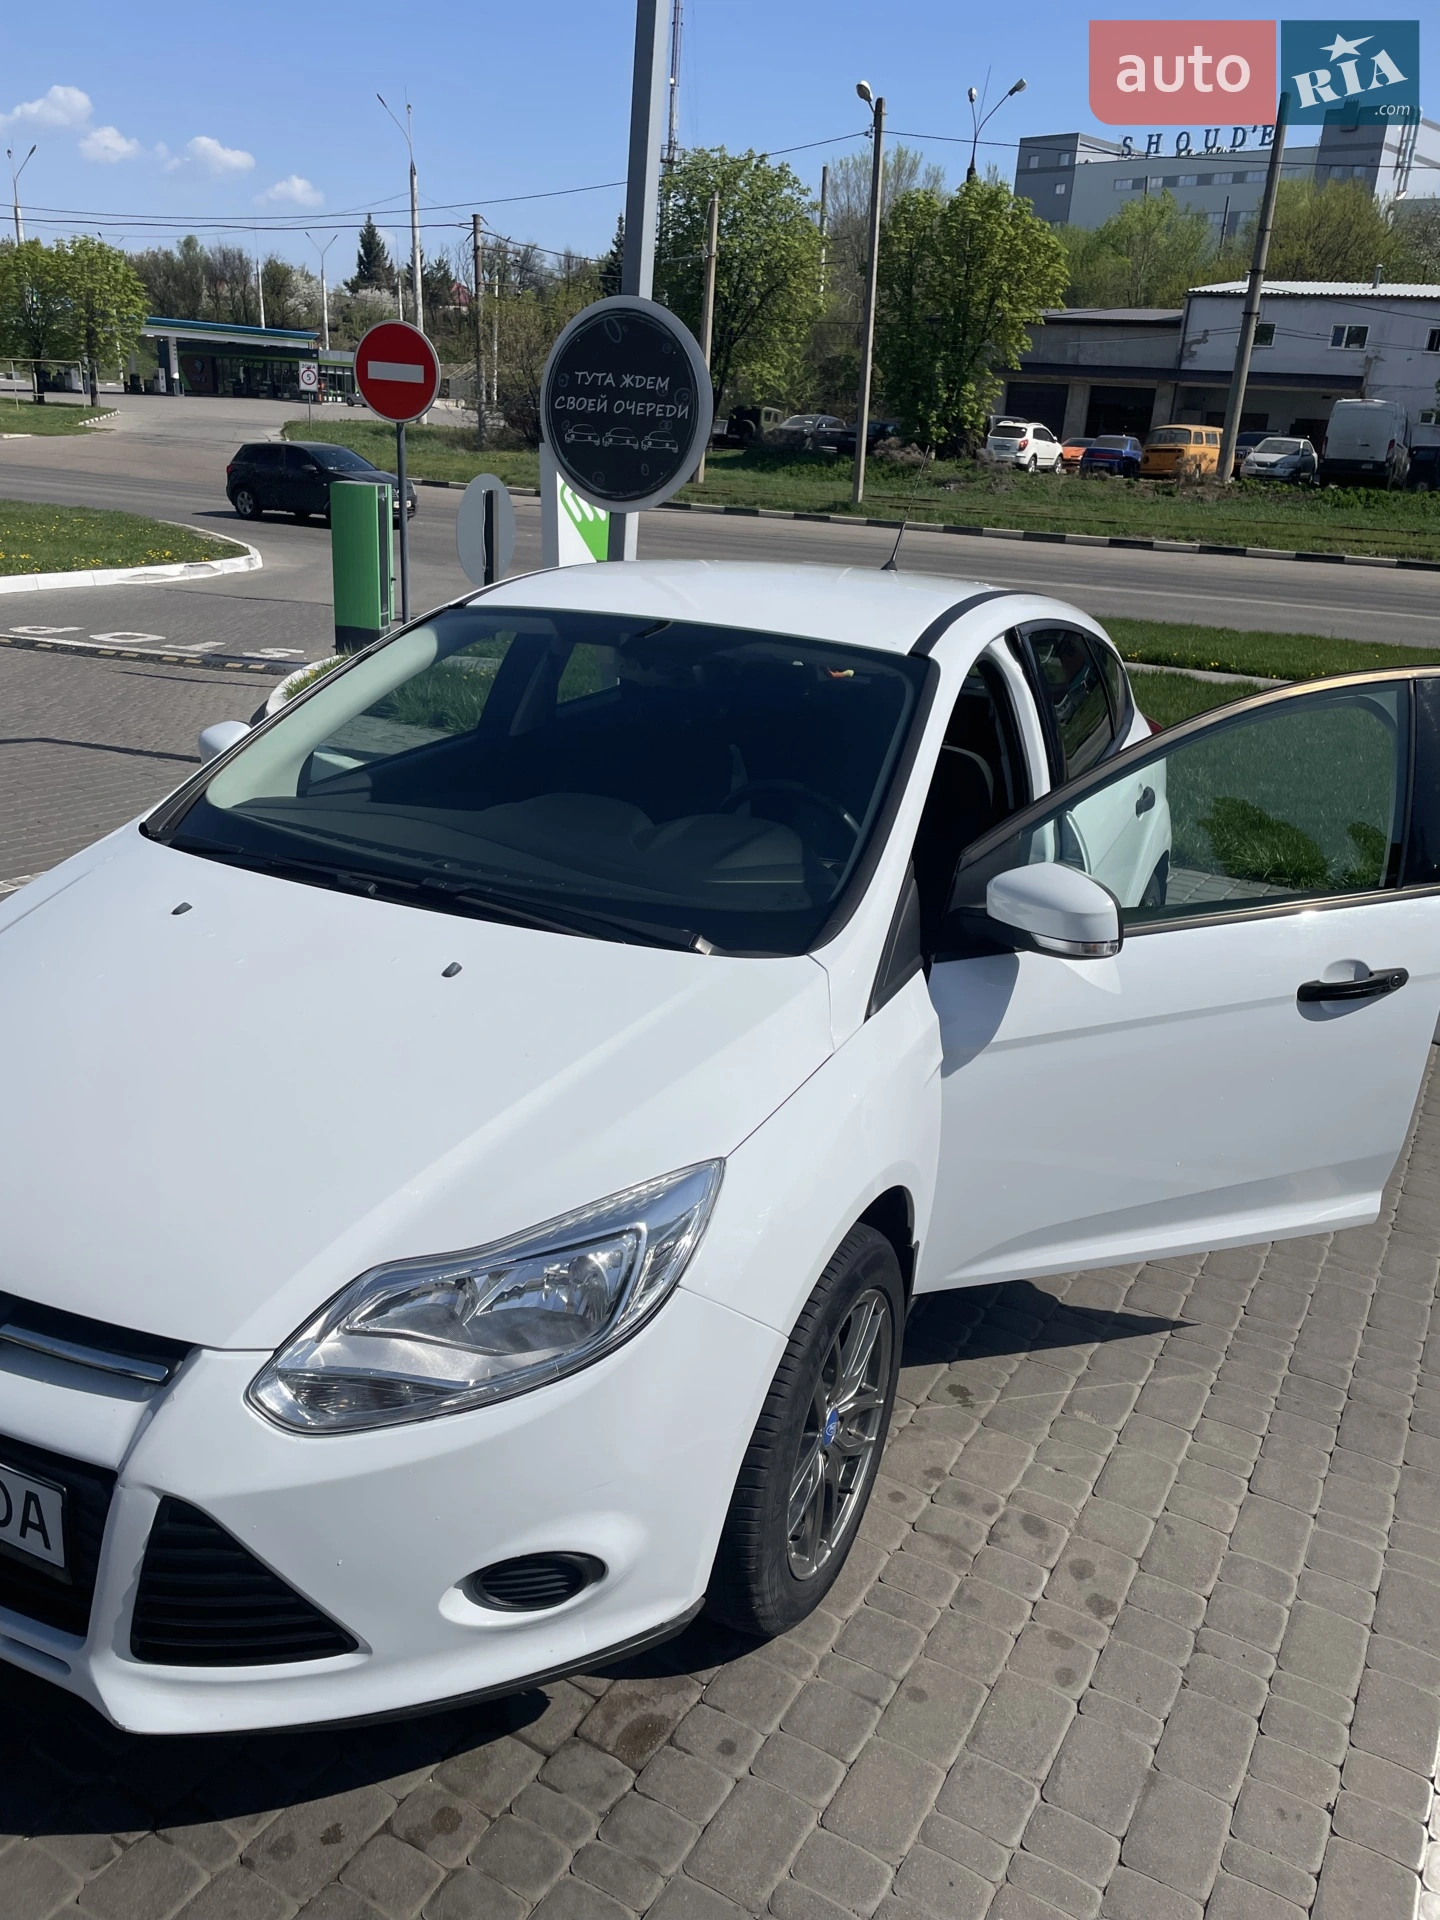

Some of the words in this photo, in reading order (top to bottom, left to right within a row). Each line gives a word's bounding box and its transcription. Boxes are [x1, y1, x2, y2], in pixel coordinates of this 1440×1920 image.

[574, 371, 616, 387] ТУТА
[619, 374, 670, 391] ЖДЕМ
[554, 394, 608, 413] СВОЕЙ
[613, 400, 689, 419] ОЧЕРЕДИ
